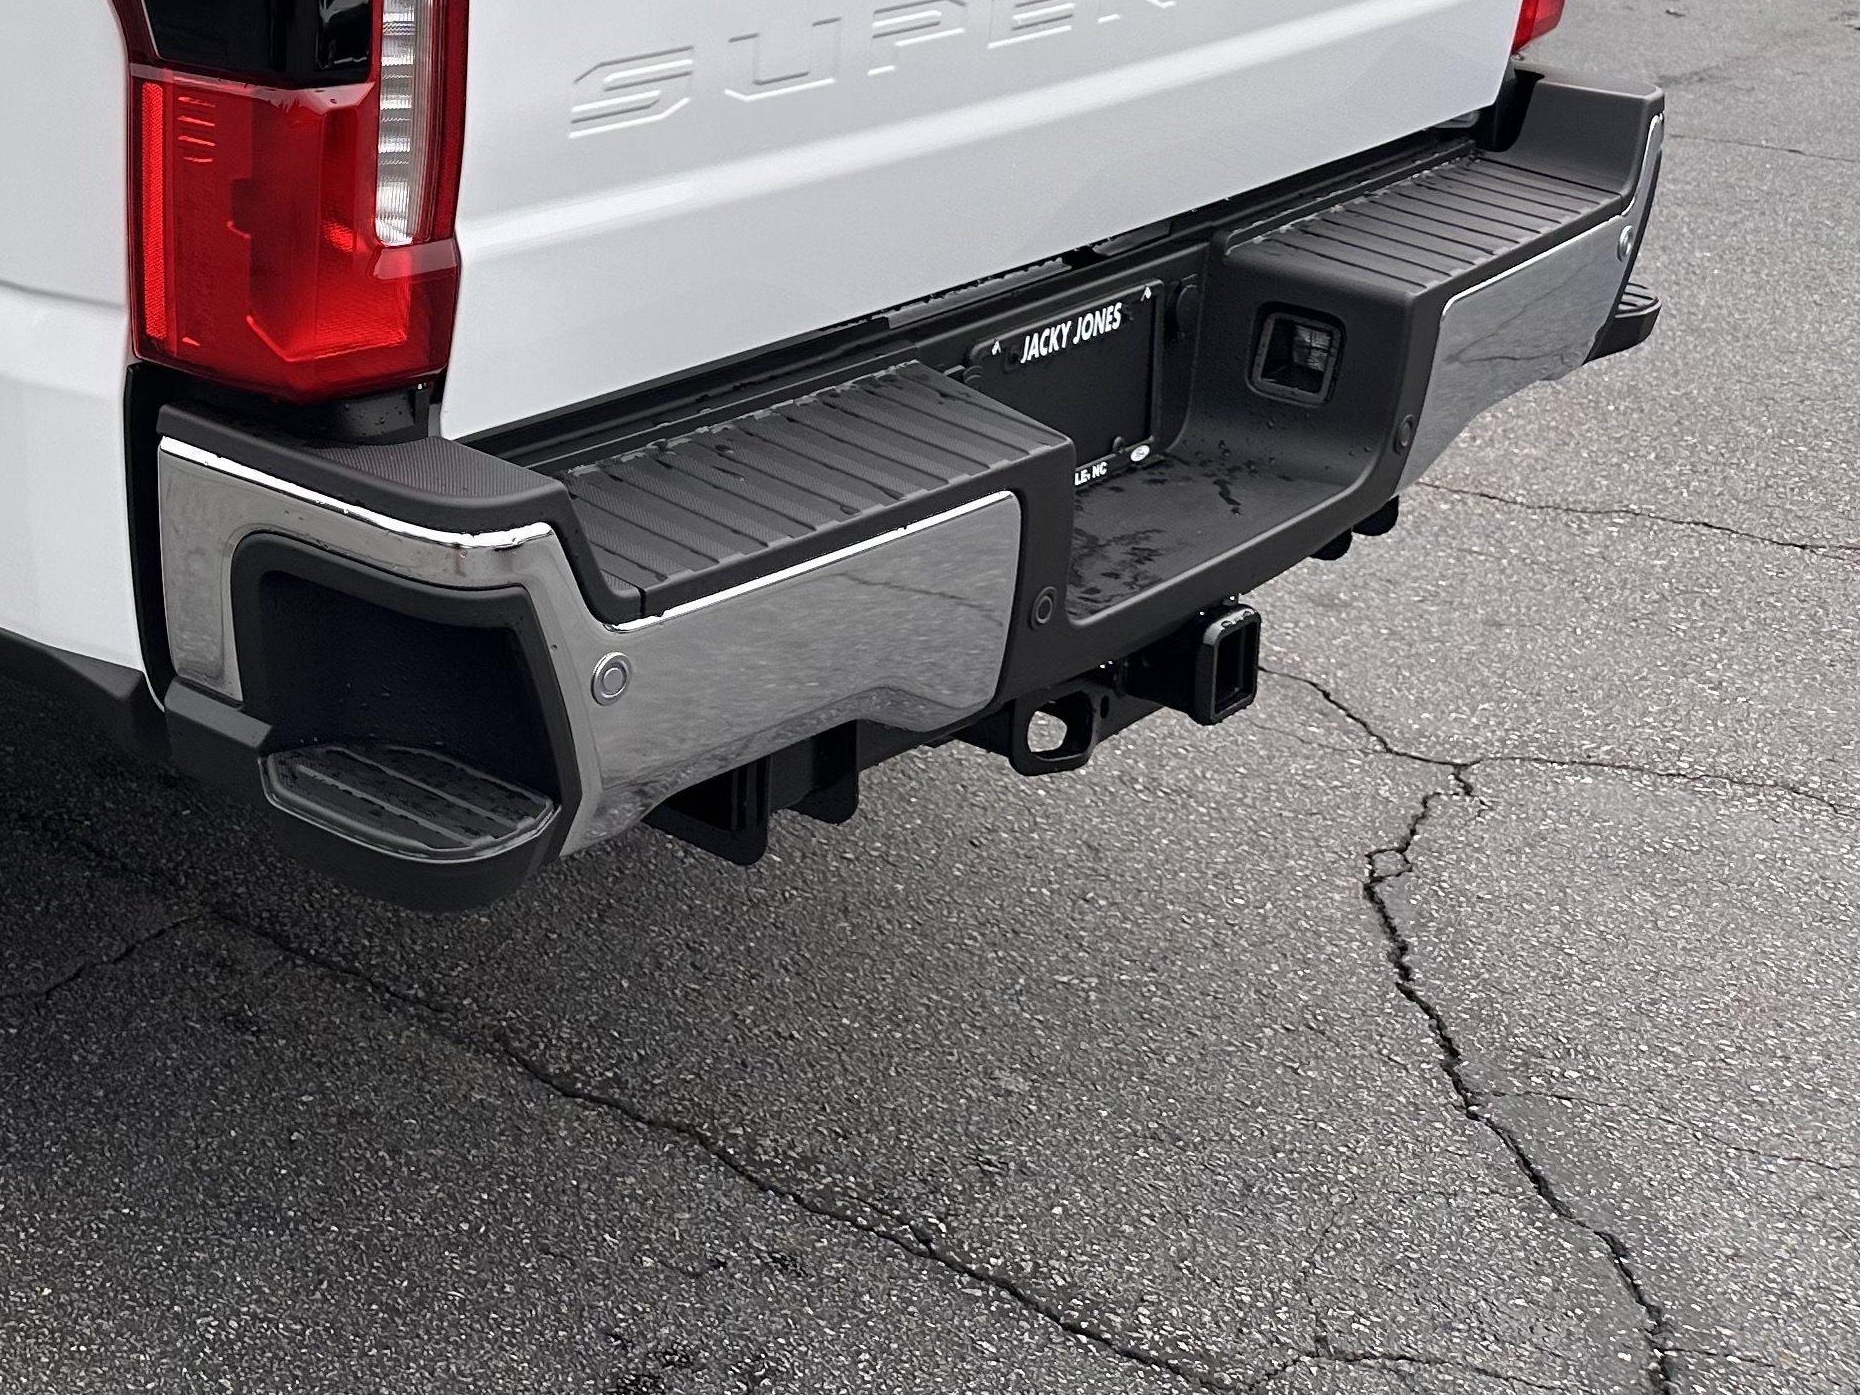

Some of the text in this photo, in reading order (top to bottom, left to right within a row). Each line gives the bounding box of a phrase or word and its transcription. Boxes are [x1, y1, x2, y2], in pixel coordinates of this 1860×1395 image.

[1020, 302, 1123, 364] JACKY JONES
[1092, 461, 1108, 479] NC
